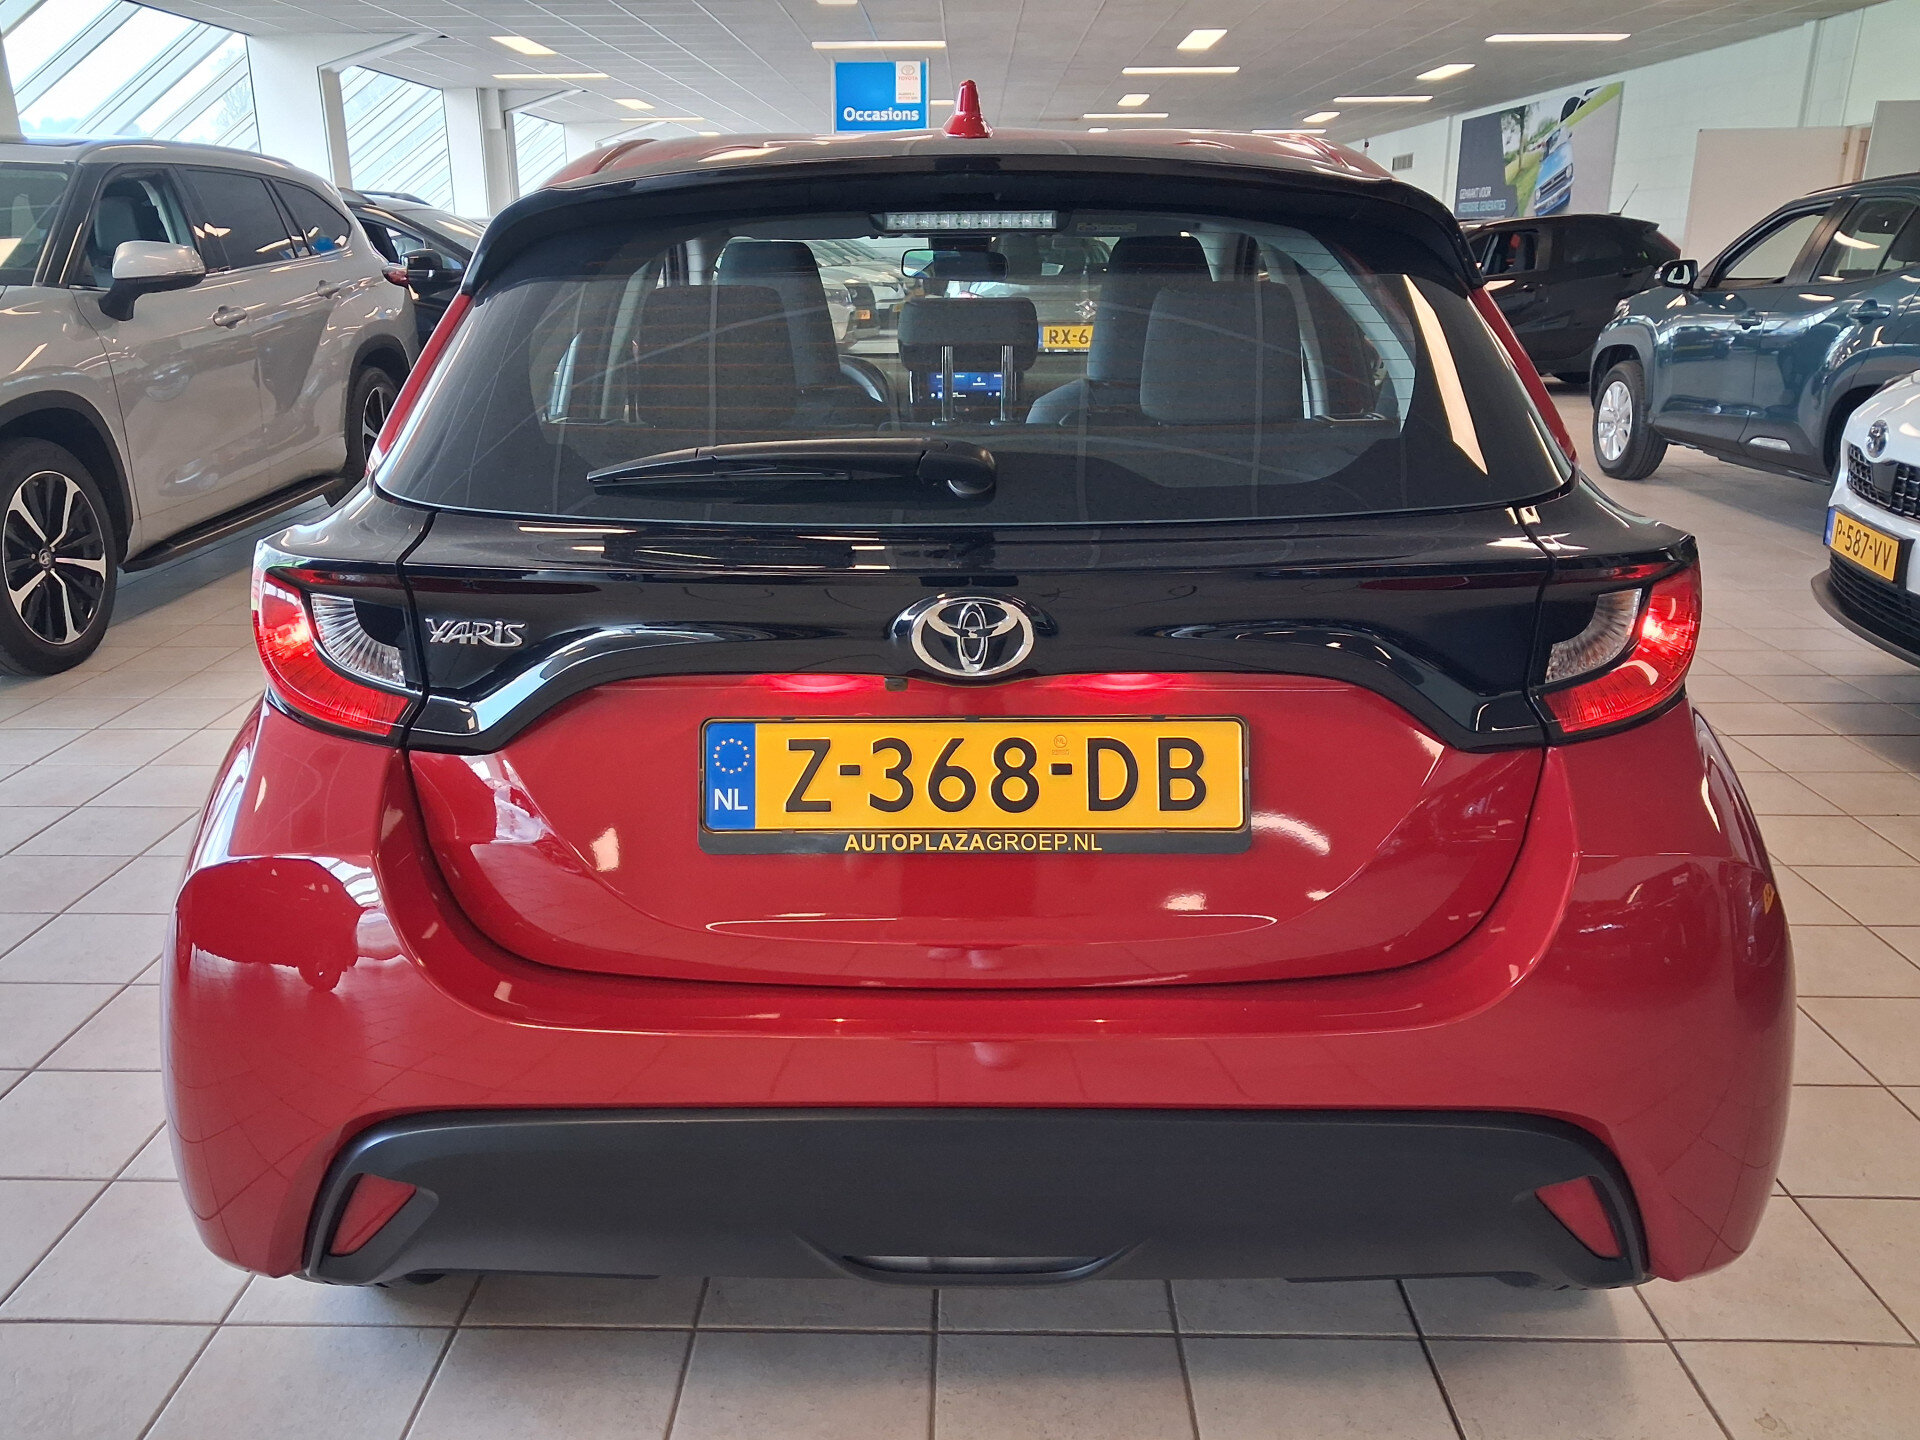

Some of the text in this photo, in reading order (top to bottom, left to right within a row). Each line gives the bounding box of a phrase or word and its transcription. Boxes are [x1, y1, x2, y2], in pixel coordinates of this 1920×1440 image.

[843, 106, 920, 122] Occasions
[1834, 518, 1892, 571] P-587-VV
[785, 736, 1207, 814] Z-368-DB
[714, 788, 749, 811] NL
[844, 833, 1102, 851] AUTOPLAZAGROEP.NL
